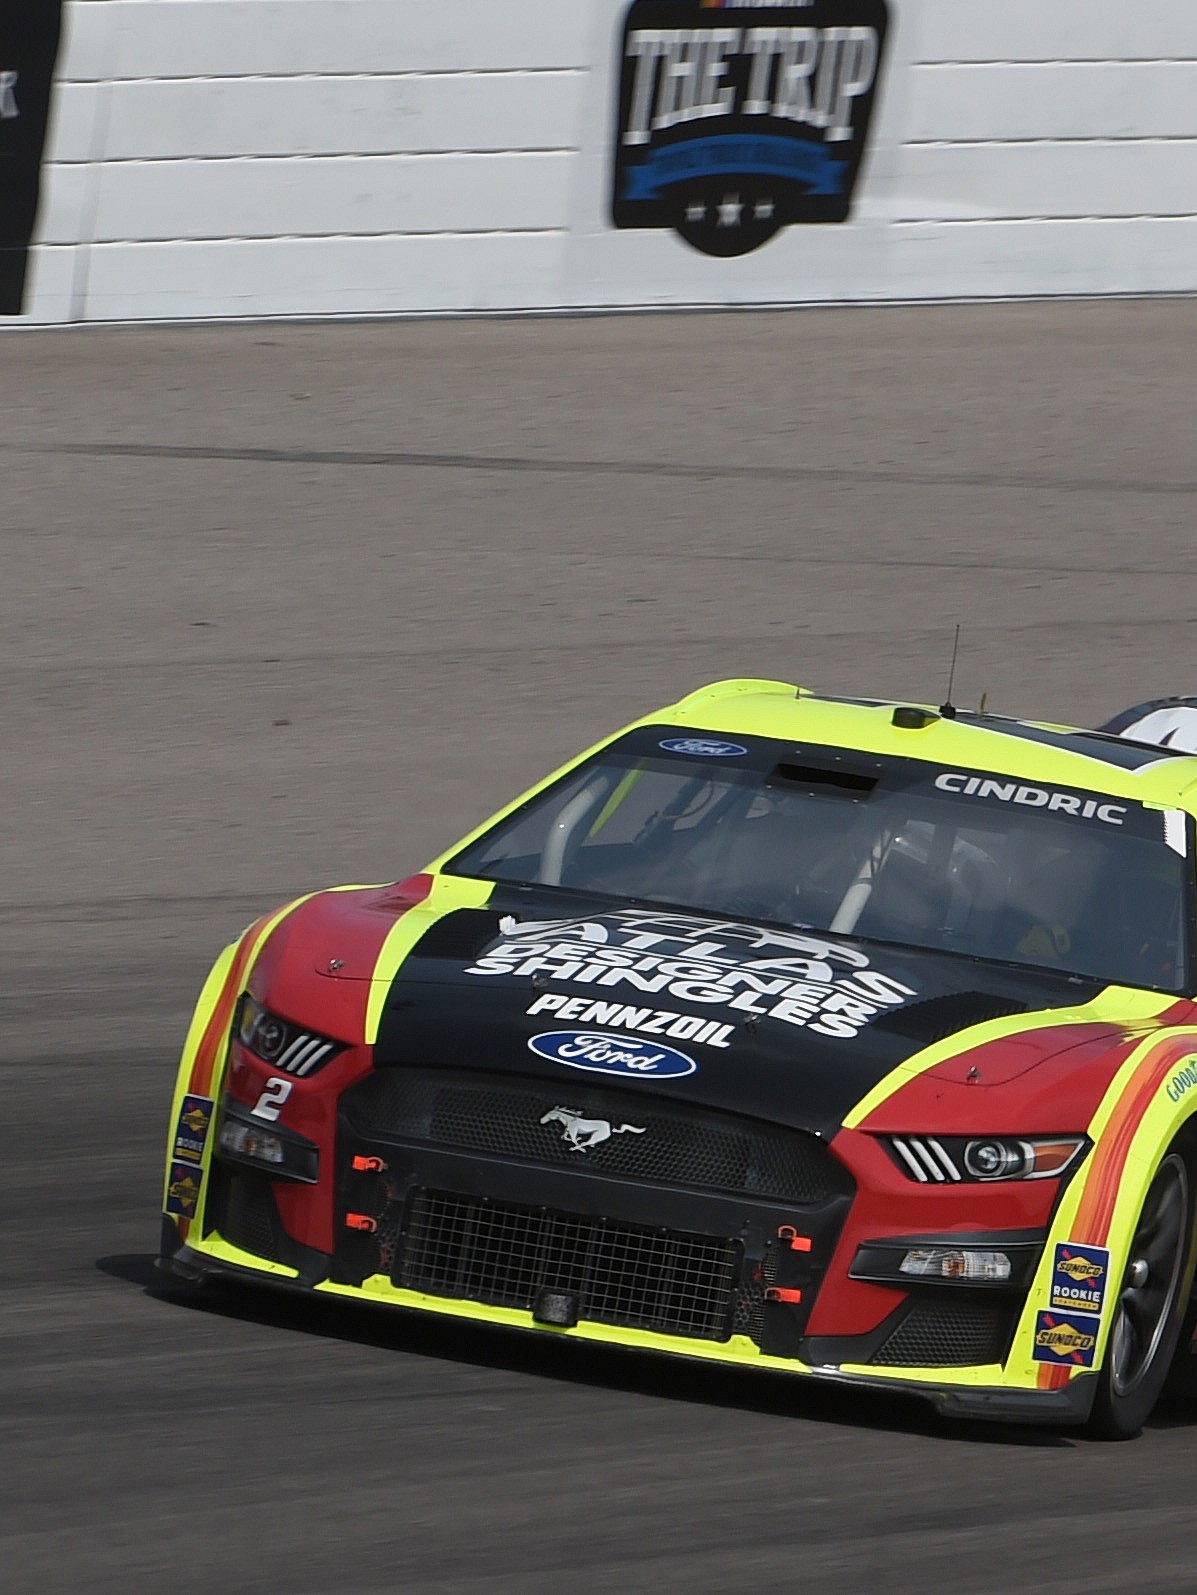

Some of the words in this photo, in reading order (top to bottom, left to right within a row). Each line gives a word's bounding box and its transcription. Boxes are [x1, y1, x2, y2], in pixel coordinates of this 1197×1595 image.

[622, 28, 744, 145] THE
[741, 26, 879, 141] TRIP
[934, 773, 1128, 825] CINDRIC
[485, 943, 878, 1024] DESIGNER
[514, 919, 919, 1005] ATLAS
[463, 957, 866, 1039] SHINGLES
[525, 993, 735, 1048] PENNZOIL
[557, 1034, 666, 1071] Ford
[251, 1077, 293, 1121] 2
[1053, 1285, 1102, 1302] ROOKIE
[1058, 1262, 1103, 1277] SUNOCO
[1038, 1331, 1092, 1348] SUNOCO
